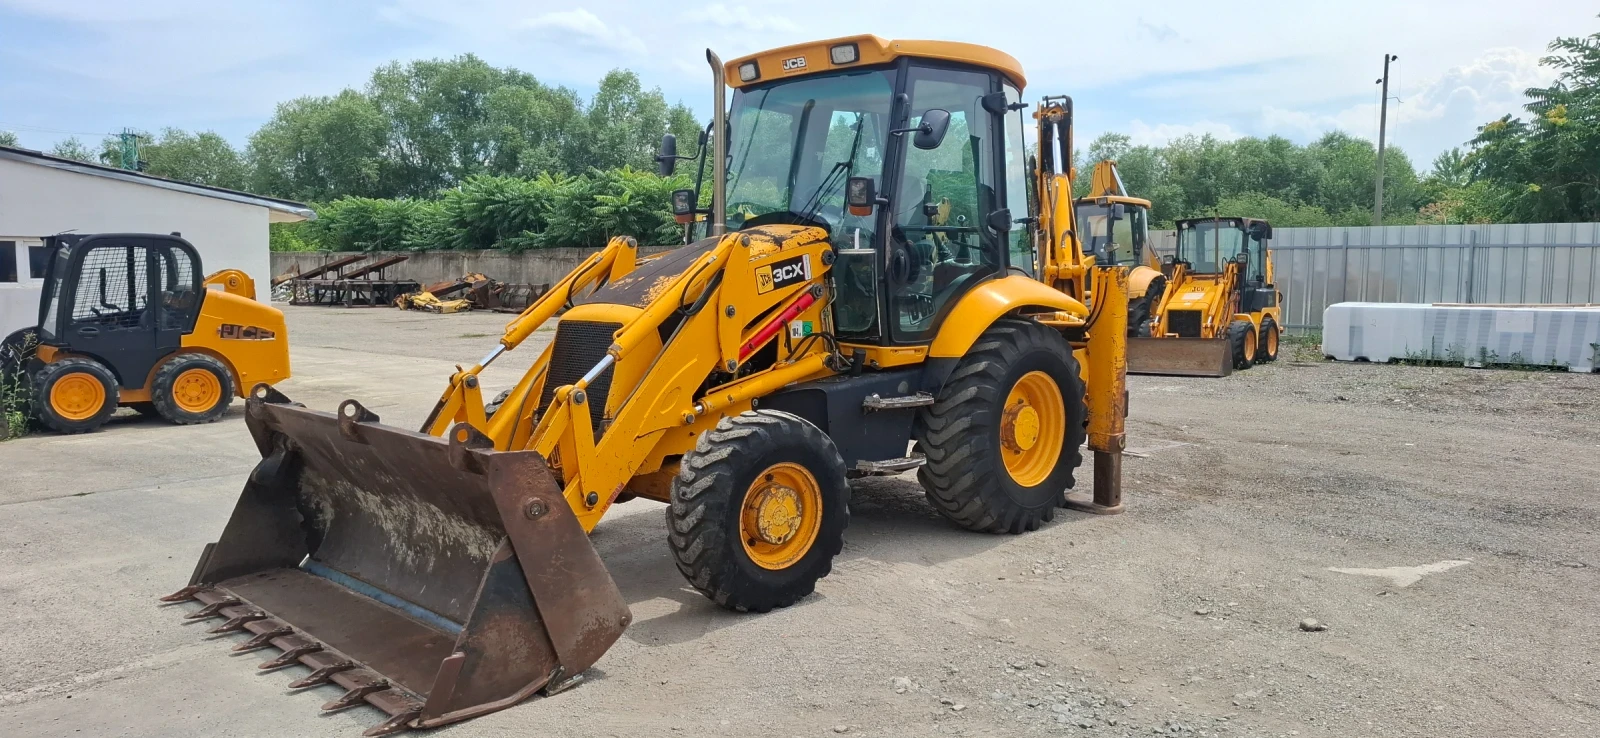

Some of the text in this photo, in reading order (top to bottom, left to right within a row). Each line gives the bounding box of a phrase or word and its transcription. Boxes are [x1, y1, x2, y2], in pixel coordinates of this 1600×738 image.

[783, 57, 806, 70] JCB
[760, 274, 772, 287] JCB
[773, 262, 804, 283] 3CX
[222, 325, 275, 339] JCB
